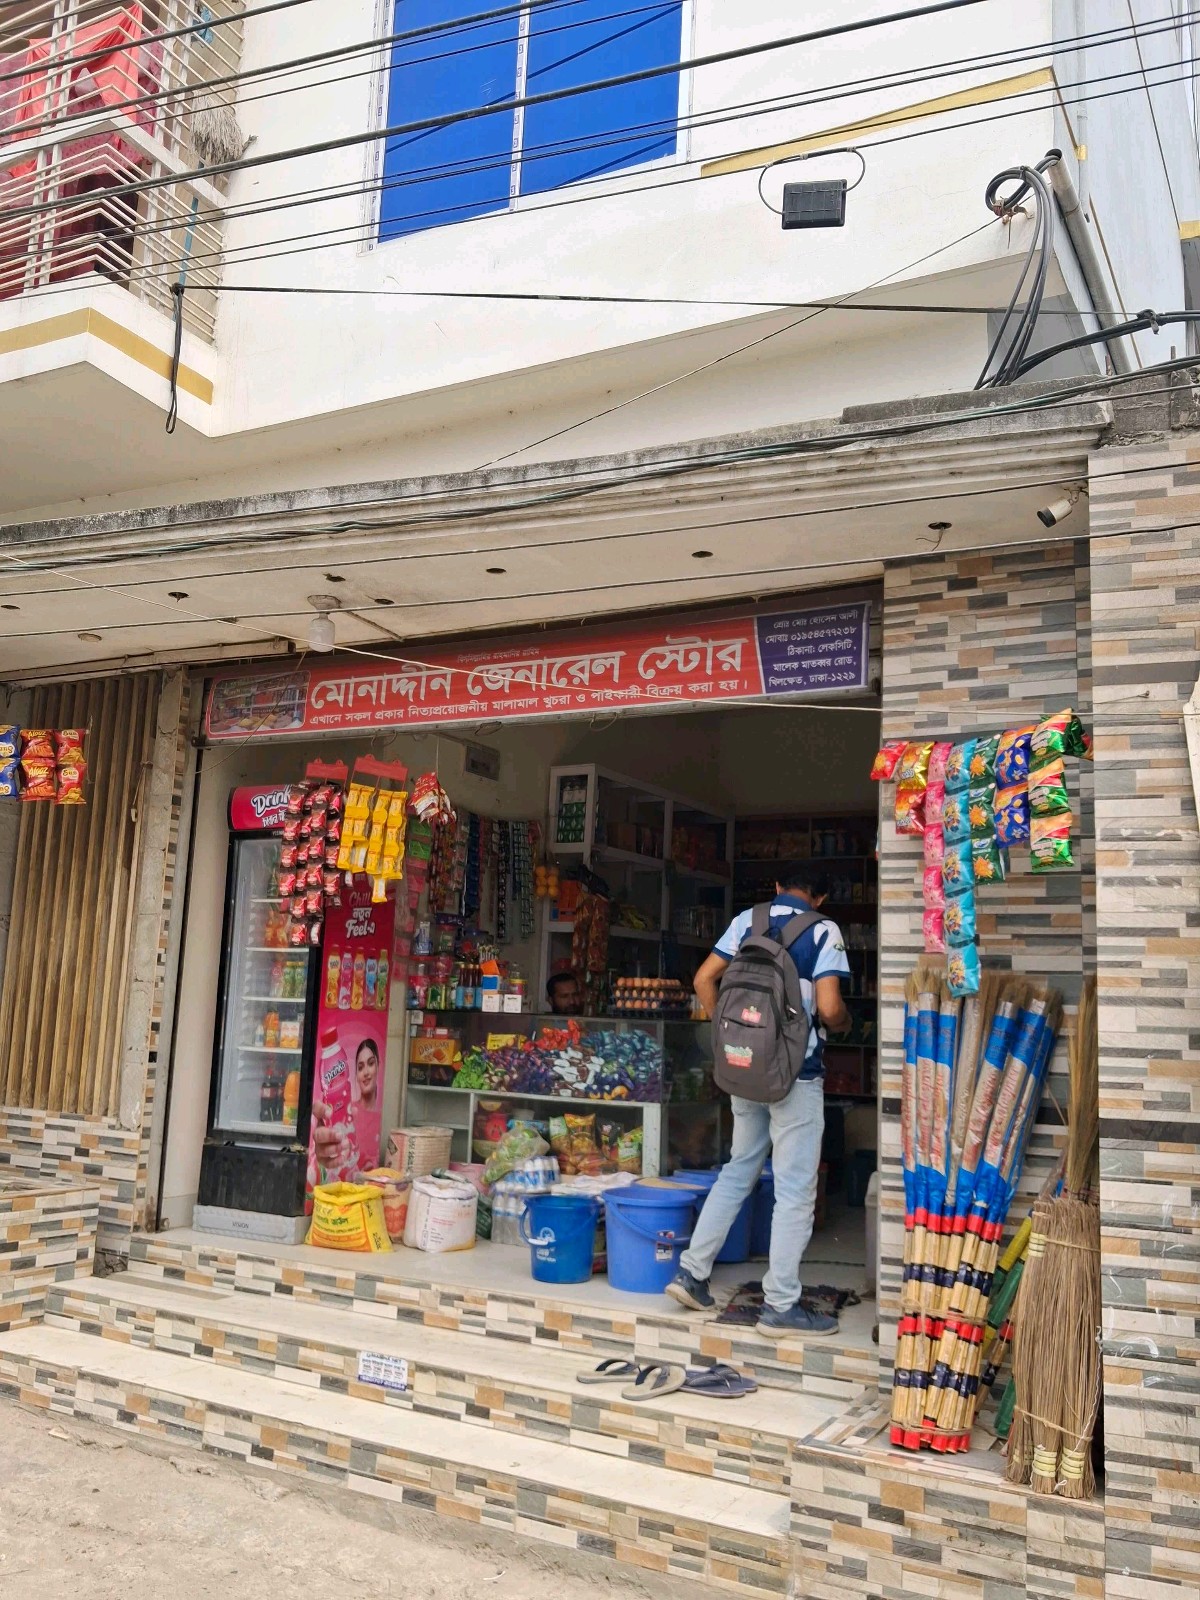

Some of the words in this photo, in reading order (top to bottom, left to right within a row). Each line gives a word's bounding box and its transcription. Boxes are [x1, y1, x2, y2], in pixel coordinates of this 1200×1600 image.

[809, 615, 837, 625] হোসেন
[311, 663, 455, 709] মোনাদ্দীন
[467, 651, 627, 695] জেনারেল
[638, 634, 749, 679] স্টোর
[773, 662, 799, 672] মালেক
[310, 714, 342, 725] এখানে
[345, 712, 372, 722] সকল
[375, 709, 404, 720] প্রকার
[408, 700, 488, 717] নিত্যপ্রয়োজনীয়
[492, 697, 539, 711] মালামাল
[543, 695, 572, 709] খুচরা
[576, 694, 586, 703] ও
[645, 683, 684, 697] বিক্রয়
[688, 681, 714, 693] করা
[251, 784, 291, 817] Drink
[352, 906, 373, 921] নতুন
[232, 1221, 249, 1229] VISION
